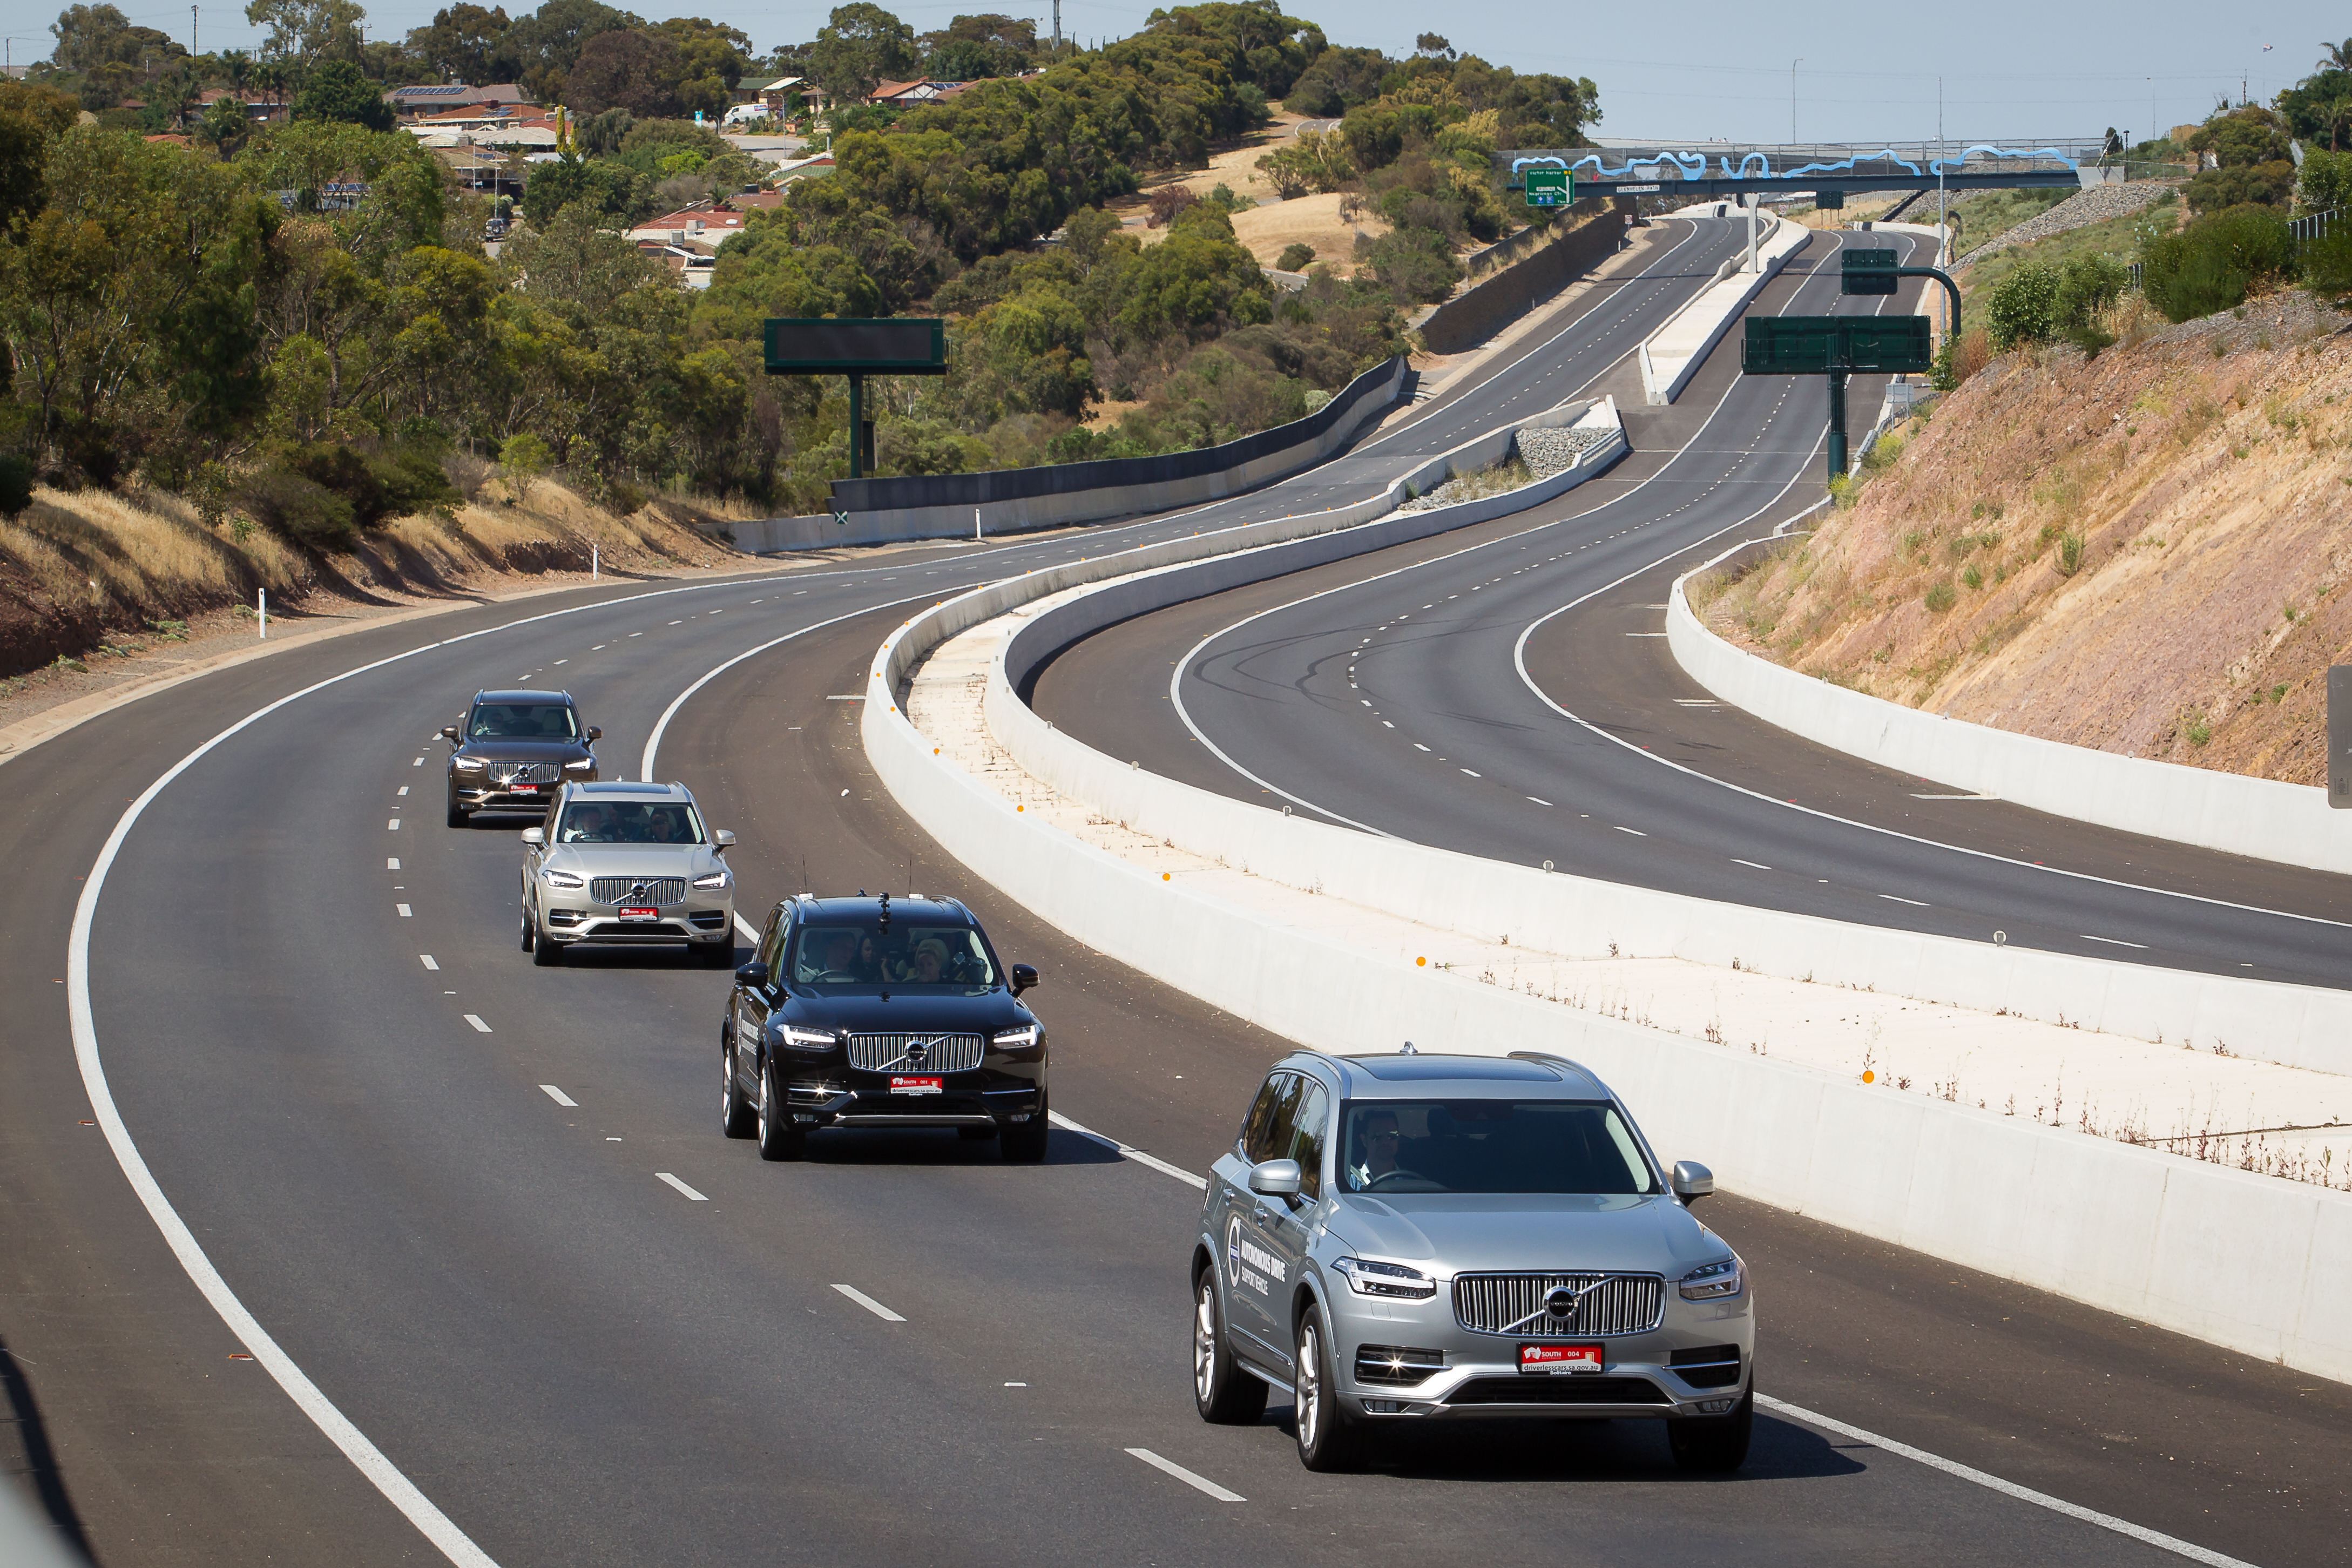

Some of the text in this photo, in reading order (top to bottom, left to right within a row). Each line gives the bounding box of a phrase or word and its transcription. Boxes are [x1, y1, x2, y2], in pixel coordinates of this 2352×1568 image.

[1241, 1239, 1286, 1282] AUTONOMOUS DRIVE
[1242, 1266, 1268, 1296] SUPPORT VEHICLE
